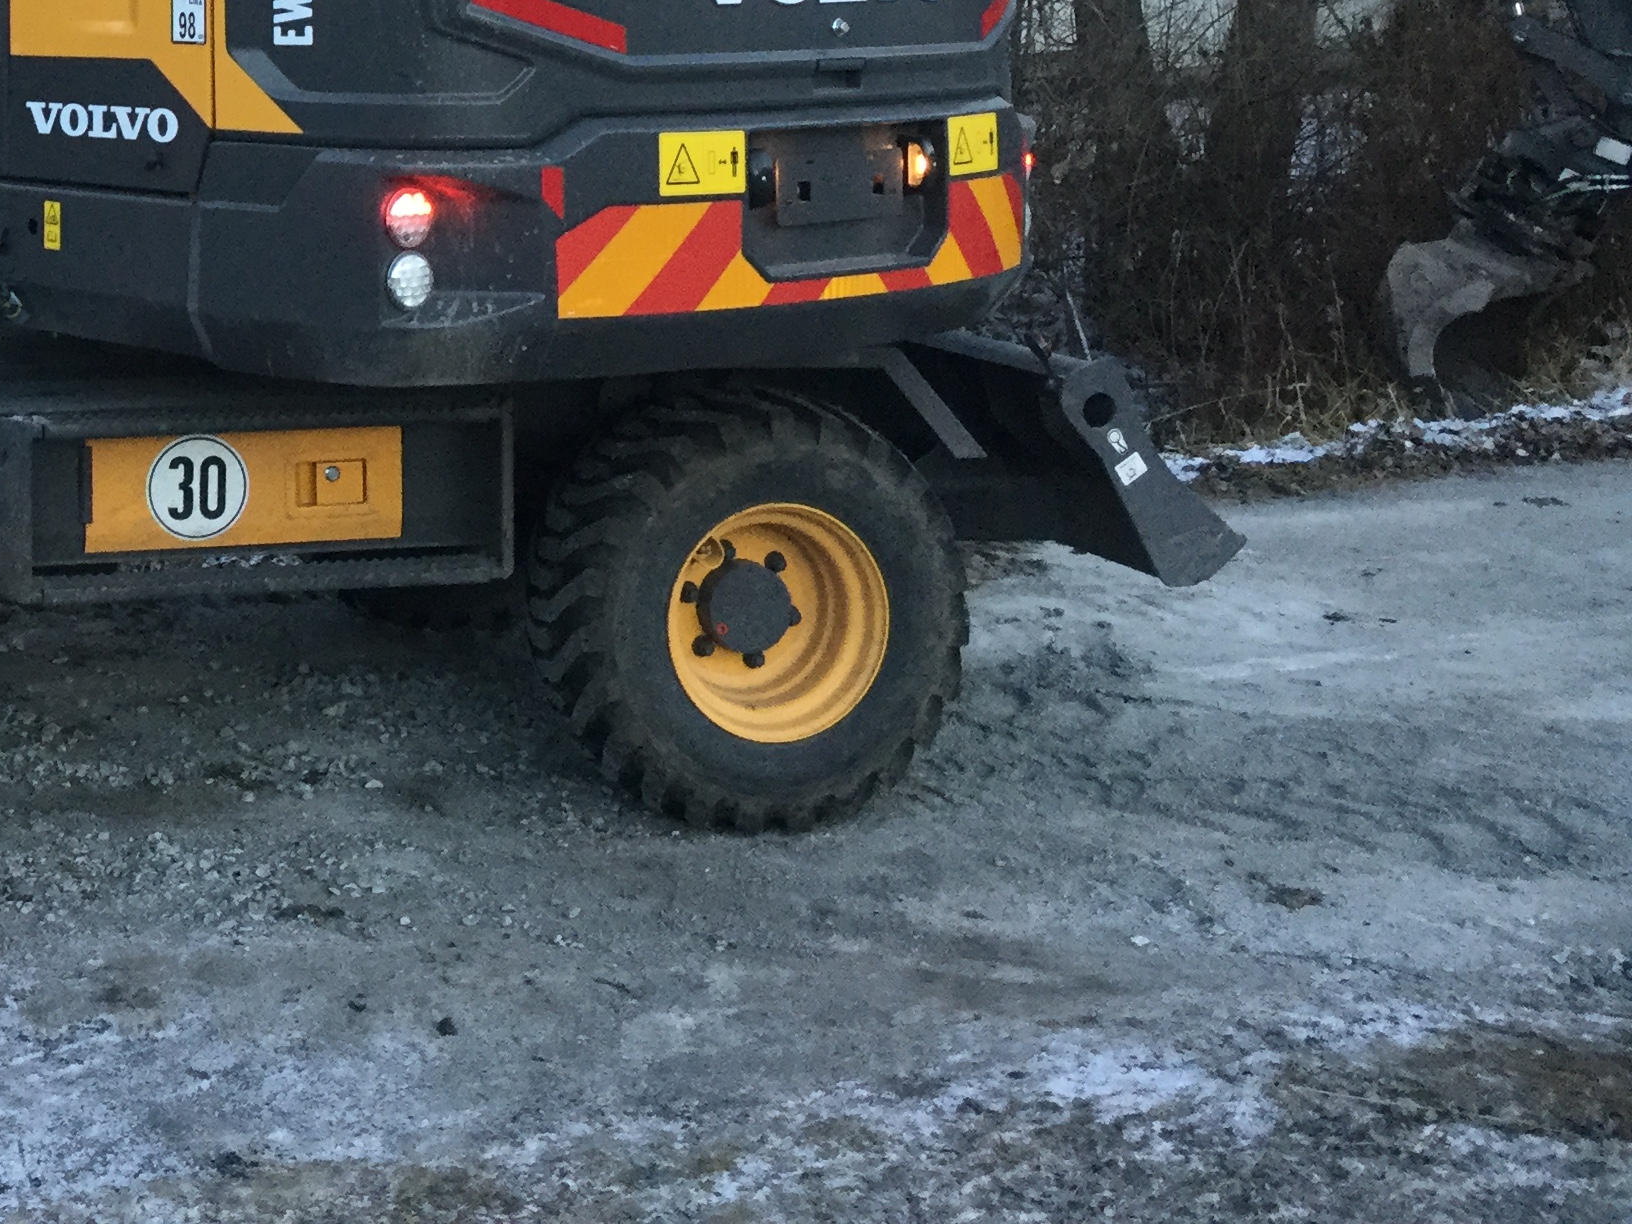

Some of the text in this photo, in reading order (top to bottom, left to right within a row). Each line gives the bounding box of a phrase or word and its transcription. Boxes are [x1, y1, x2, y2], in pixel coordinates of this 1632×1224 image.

[179, 12, 196, 39] 98
[26, 101, 179, 143] VOLVO
[167, 455, 227, 520] 30
